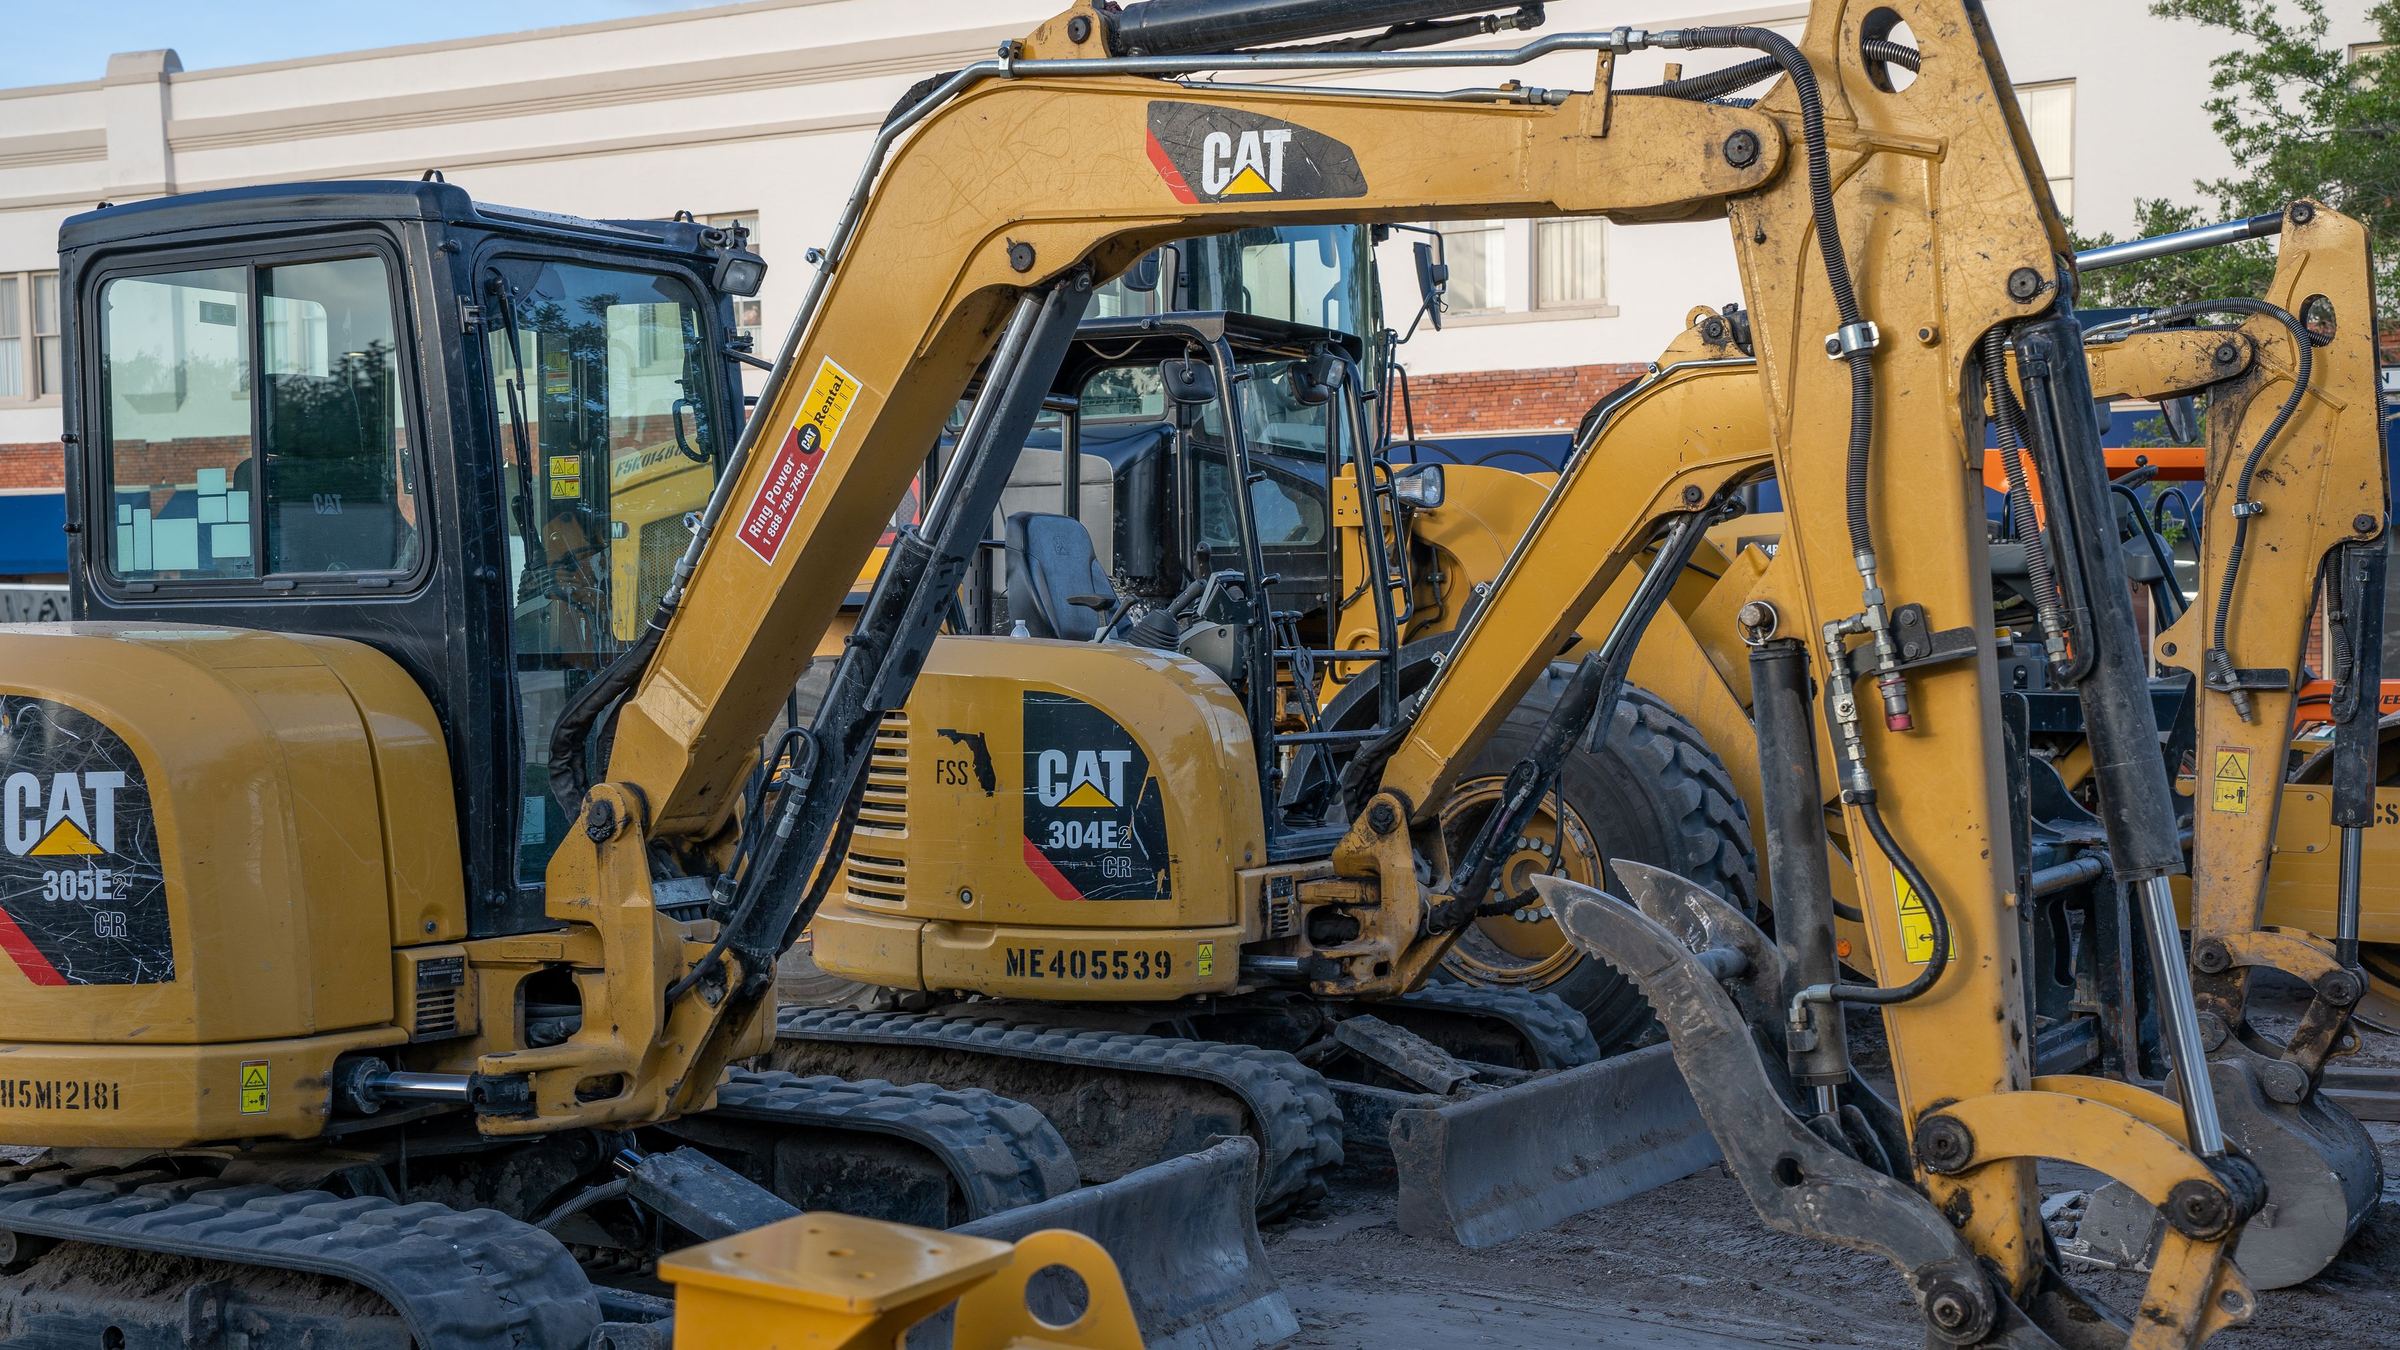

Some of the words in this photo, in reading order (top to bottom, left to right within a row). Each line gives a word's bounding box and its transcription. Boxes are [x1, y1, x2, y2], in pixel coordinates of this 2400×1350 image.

[1202, 129, 1292, 195] CAT
[813, 375, 844, 426] Rental
[801, 427, 817, 450] CAT
[312, 493, 344, 515] CAT
[748, 505, 773, 538] Ring
[764, 457, 795, 505] Power
[762, 537, 771, 546] 1
[767, 514, 782, 538] 888
[778, 462, 809, 514] 748-7464
[936, 759, 968, 786] FSS
[1038, 749, 1132, 808] CAT
[4, 771, 126, 856] CAT
[1102, 856, 1132, 878] CR
[94, 911, 127, 938] CR
[1006, 947, 1172, 980] ME405539
